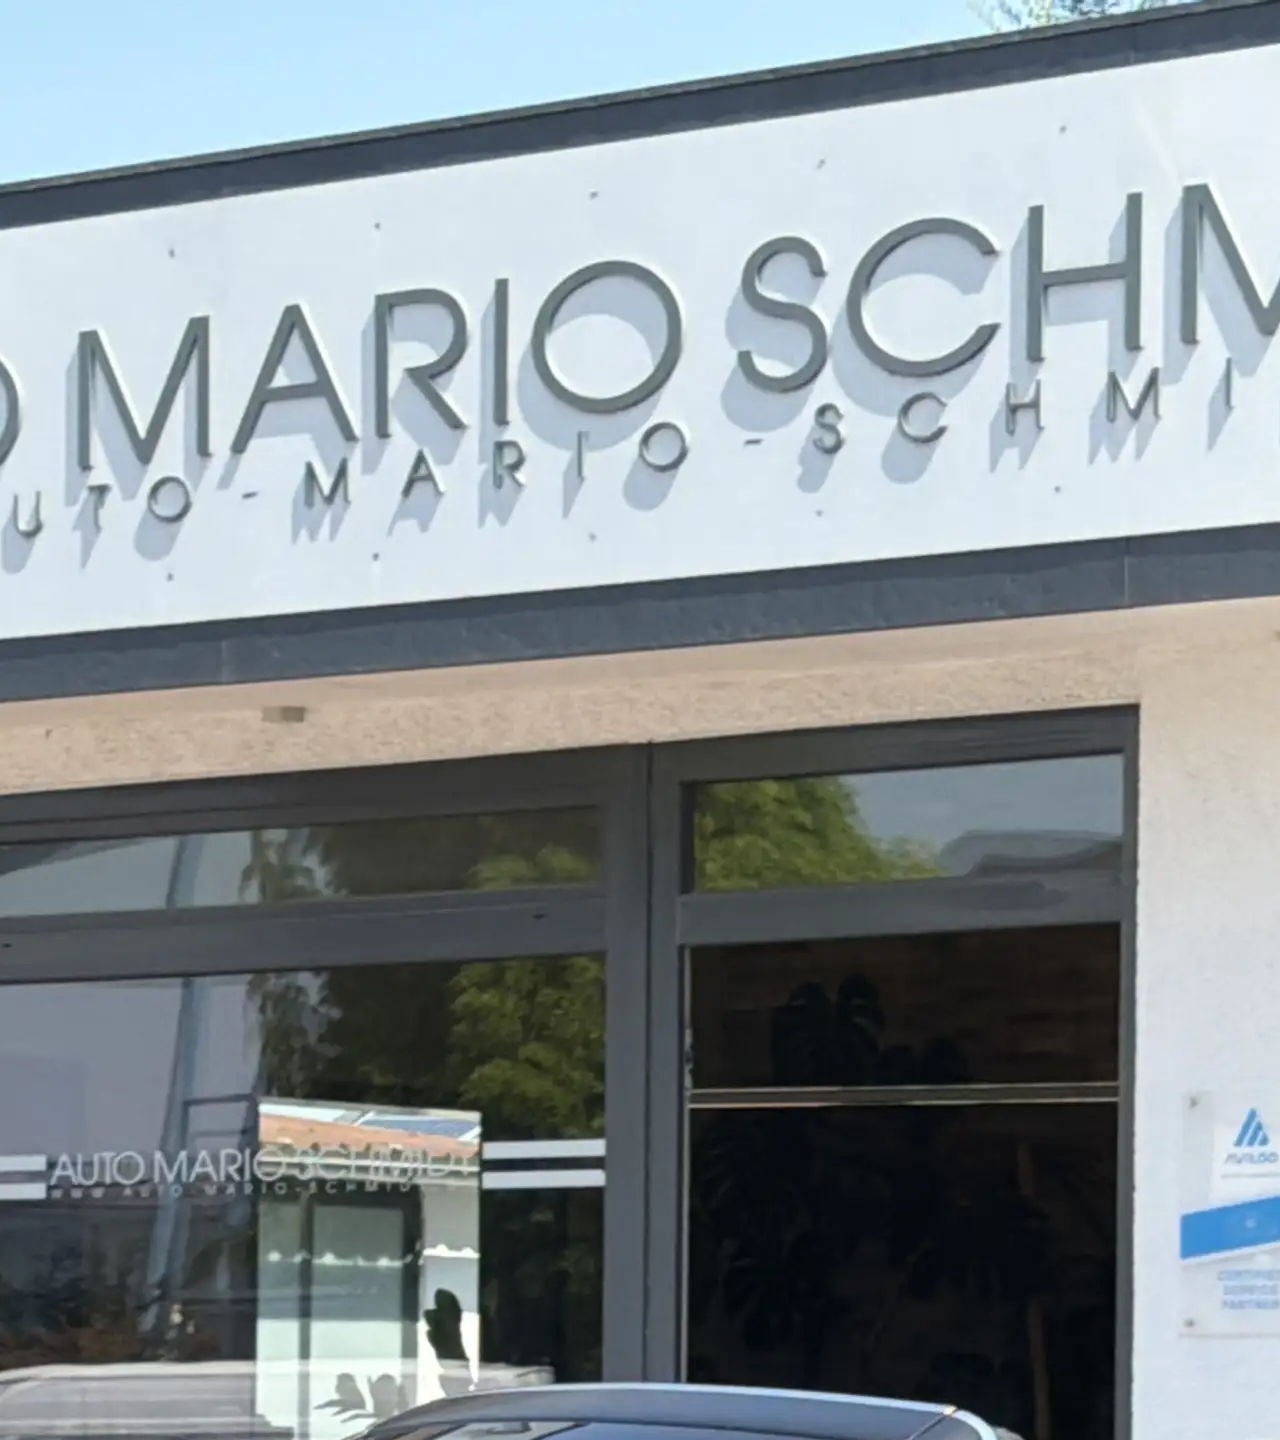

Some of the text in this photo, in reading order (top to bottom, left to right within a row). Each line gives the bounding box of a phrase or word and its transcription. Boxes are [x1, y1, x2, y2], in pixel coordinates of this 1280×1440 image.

[76, 259, 683, 472] MARIO
[50, 1150, 146, 1187] AUTO
[152, 1147, 287, 1183] MARIO
